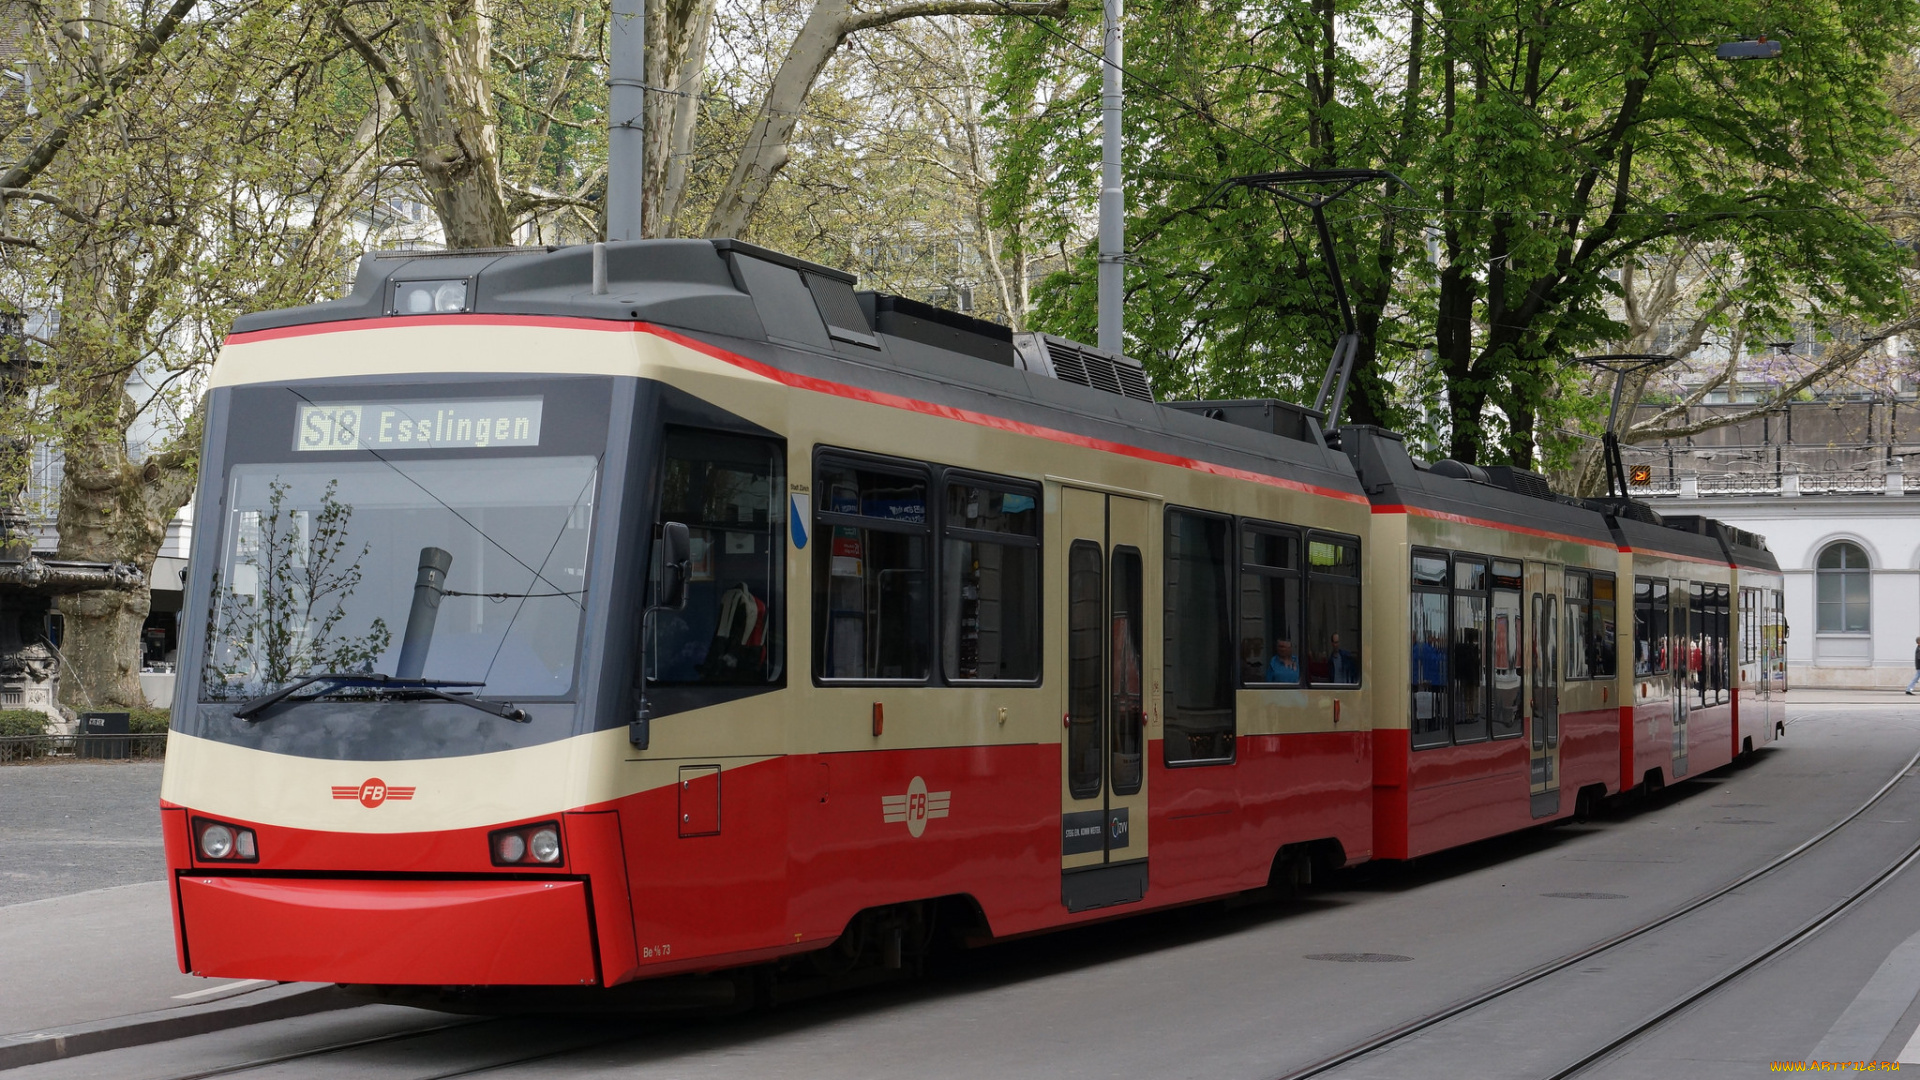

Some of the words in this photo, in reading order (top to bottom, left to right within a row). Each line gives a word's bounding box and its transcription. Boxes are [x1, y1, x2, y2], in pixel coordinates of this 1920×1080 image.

[302, 408, 359, 447] S18
[378, 409, 530, 447] Esslingen
[361, 785, 385, 801] FB
[908, 793, 926, 821] FB
[643, 946, 653, 958] Be
[662, 944, 671, 956] 73
